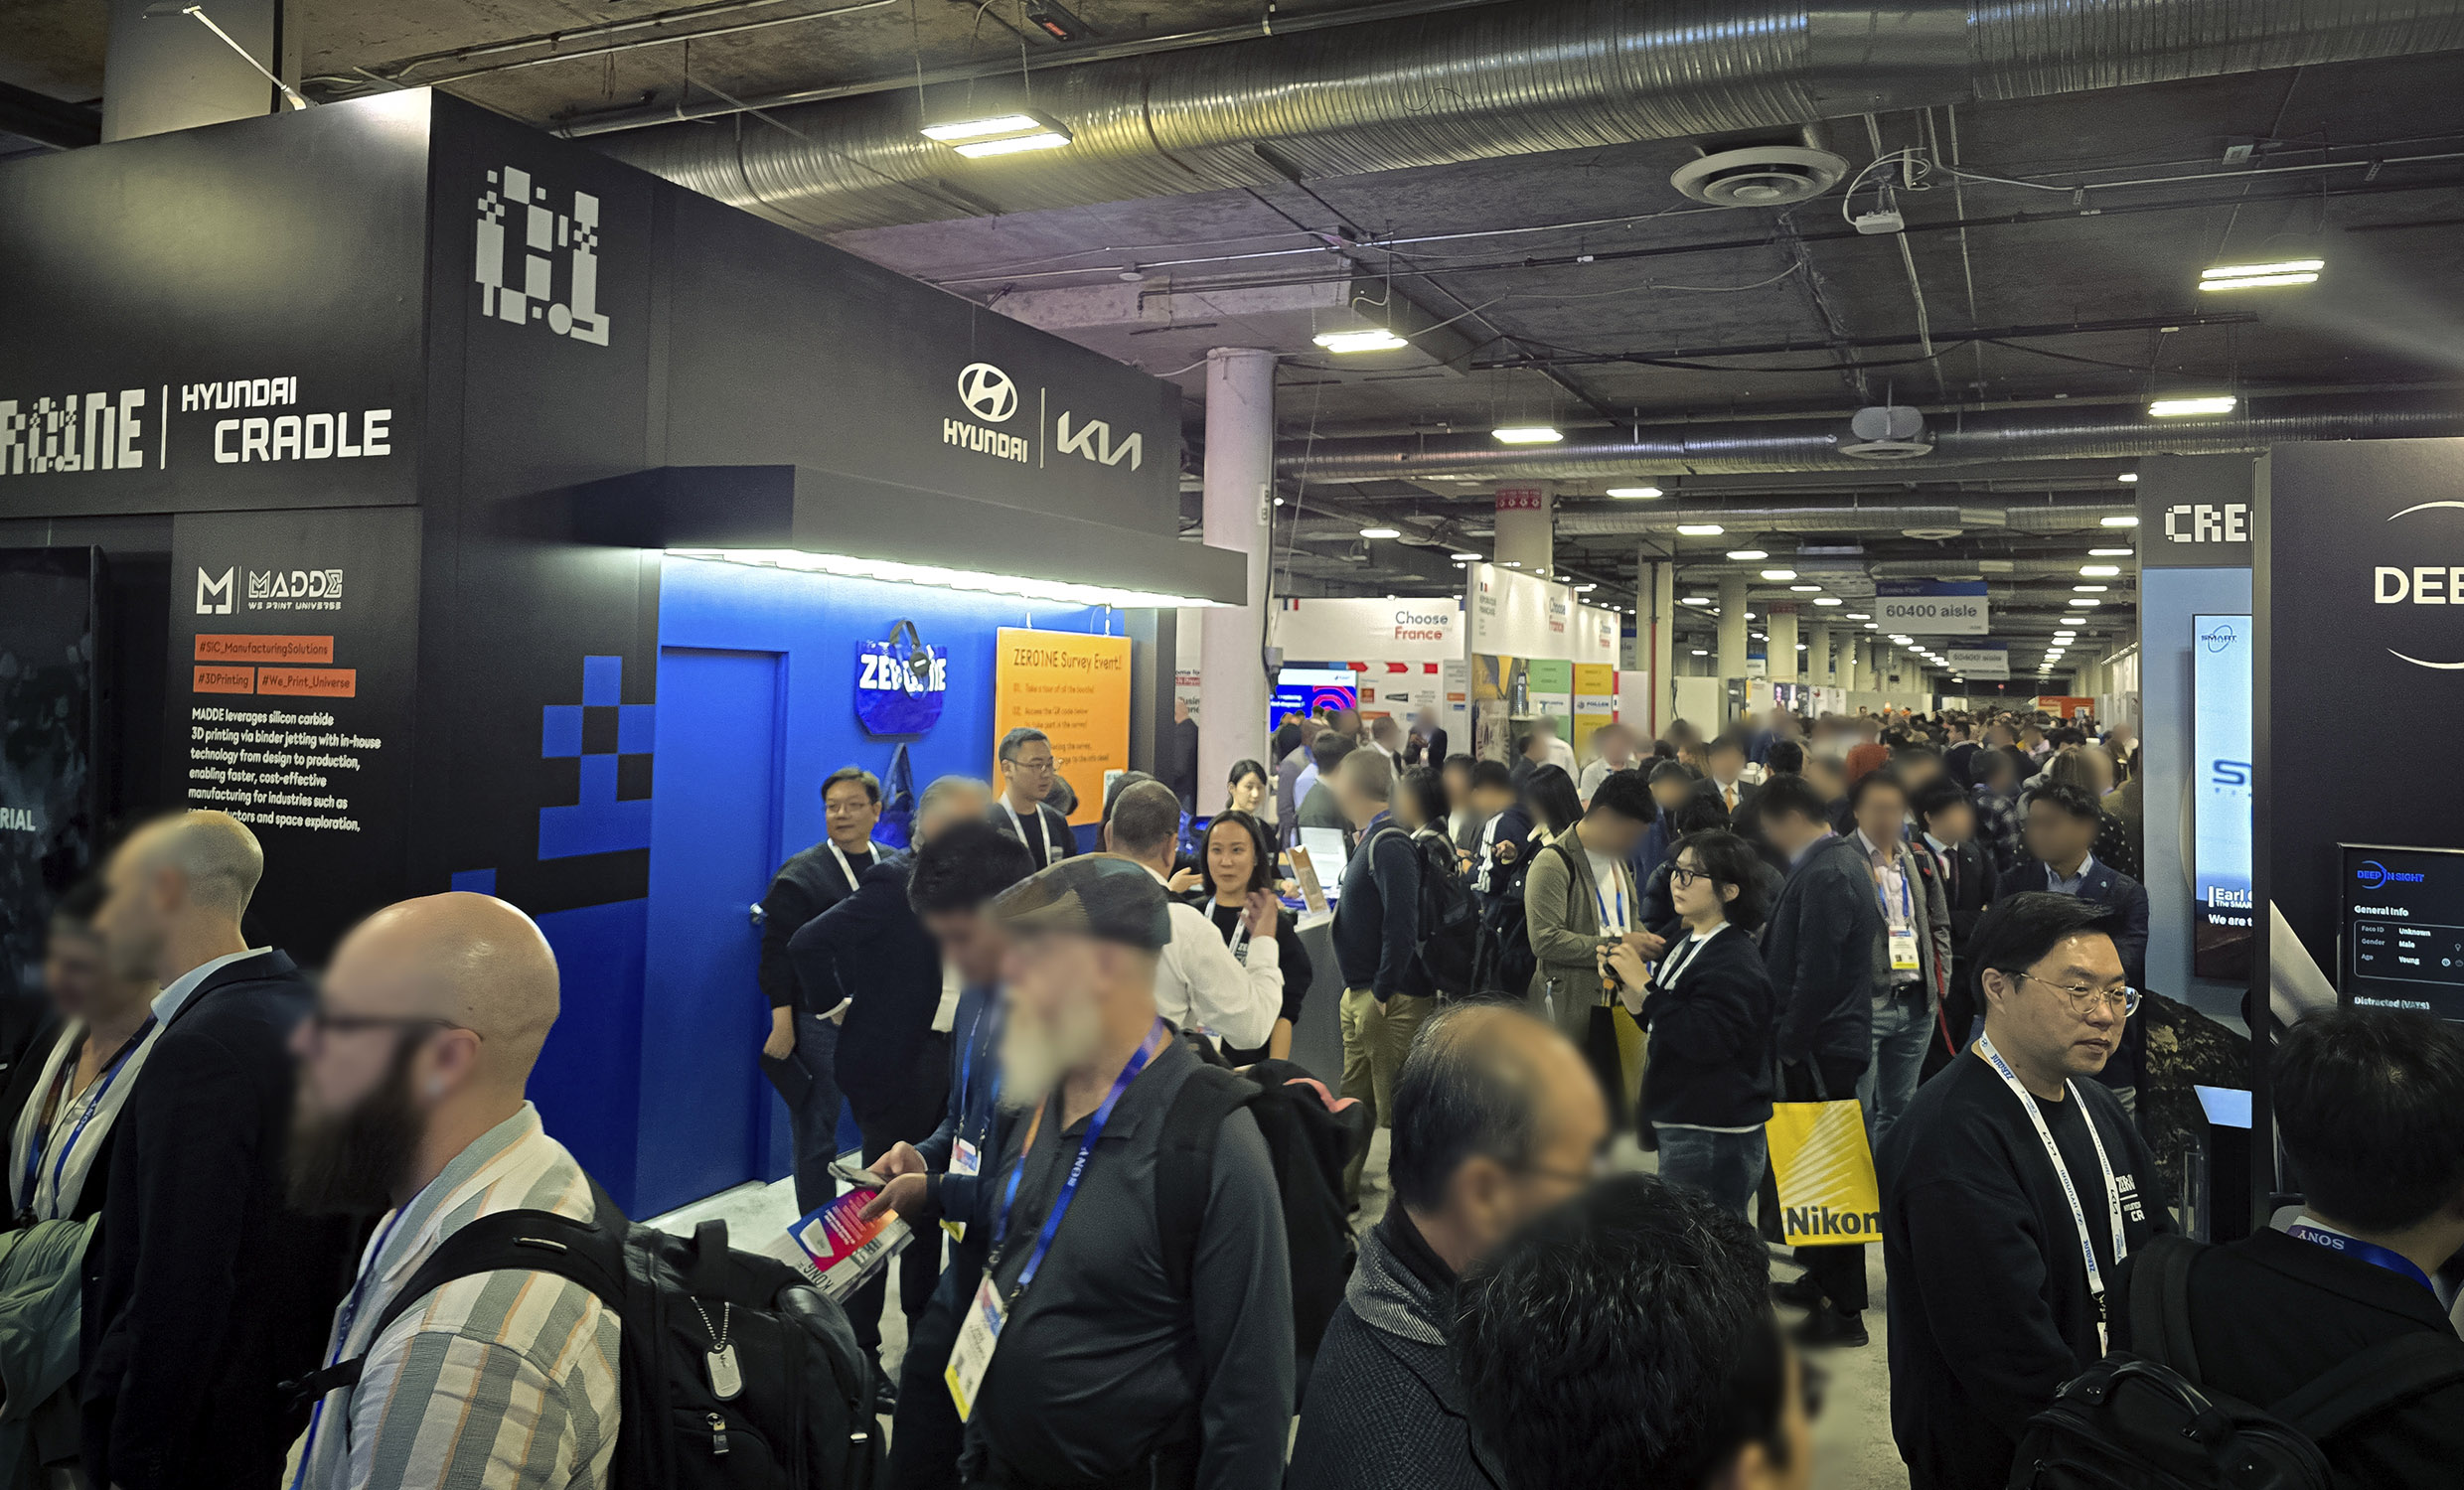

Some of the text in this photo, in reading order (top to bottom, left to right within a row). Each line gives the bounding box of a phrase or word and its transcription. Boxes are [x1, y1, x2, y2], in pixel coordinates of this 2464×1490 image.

[182, 376, 297, 412] HYUNDAI
[214, 409, 392, 464] CRADLE
[943, 410, 1143, 472] HYUNDAI KIA
[2165, 504, 2252, 542] CRE
[1395, 610, 1449, 625] Choose
[1886, 604, 1977, 617] 60400 aisle
[1395, 626, 1443, 641] France
[1061, 652, 1092, 673] Survey
[1094, 654, 1122, 670] Event!
[199, 673, 351, 689] #3DPrinting #We_Print_Universe
[192, 707, 334, 726] MADDE leverages silicon carbide
[192, 726, 382, 749] 3D printing via binder jetting with in-house
[191, 748, 361, 771] technology from design to production,
[189, 767, 327, 788] enabling faster, cost-effective
[189, 787, 349, 810] manufacturing for industries such as
[256, 811, 274, 824] and
[275, 813, 303, 828] space
[305, 815, 361, 831] exploration,
[2357, 870, 2382, 879] DEEP
[2209, 914, 2227, 925] We
[2229, 917, 2245, 926] are
[2355, 905, 2409, 916] General Info
[2398, 928, 2431, 937] Unknown
[2398, 957, 2420, 966] Young
[2355, 996, 2399, 1008] Distracted
[1067, 1146, 1090, 1187] SONY
[2060, 1169, 2079, 1209] HYUNDAI
[1787, 1207, 1883, 1237] Nikon
[2297, 1230, 2345, 1250] SONY
